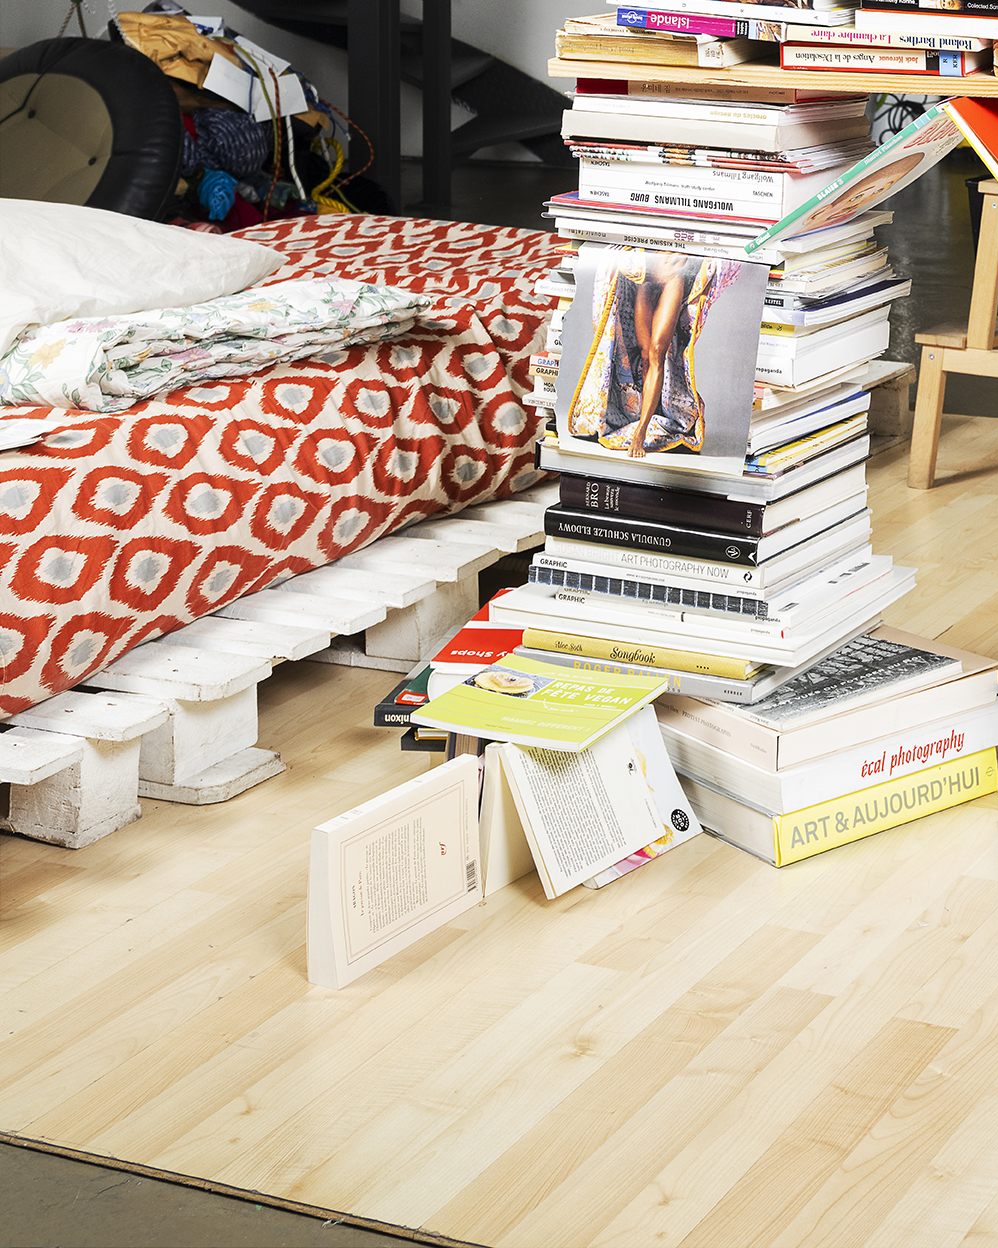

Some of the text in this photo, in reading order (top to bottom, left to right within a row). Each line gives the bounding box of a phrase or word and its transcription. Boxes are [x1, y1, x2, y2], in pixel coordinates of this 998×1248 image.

[649, 13, 690, 29] Islande
[810, 29, 891, 44] La chambre claire
[899, 35, 972, 50] Roland Barthes
[795, 51, 875, 63] Anges de la Désolation
[905, 55, 919, 64] Jack
[712, 170, 774, 184] Wolfgang Tillmans
[816, 182, 837, 201] BLAISE
[630, 192, 734, 212] WOLFGANG TILLMANS BURG
[585, 229, 607, 239] mounir
[623, 235, 686, 249] THE KISSING PRECISE
[590, 482, 600, 509] BRO
[558, 521, 672, 548] GUNDULA SCHULZE ELDOWY
[539, 558, 568, 569] GRAPHIC
[555, 543, 730, 579] SUSAN BRIGHT ART PHOTOGRAPHY NOW
[558, 593, 586, 605] GRAPHIC
[450, 649, 494, 658] Shops
[554, 640, 657, 665] Alec Soth Songbook
[840, 655, 923, 686] POTAGER ROI
[551, 681, 616, 695] REPAS DE
[539, 688, 633, 706] FÊTE VEGAN
[861, 729, 966, 779] écal photography
[790, 766, 981, 850] ART & AUJOURD'HUI
